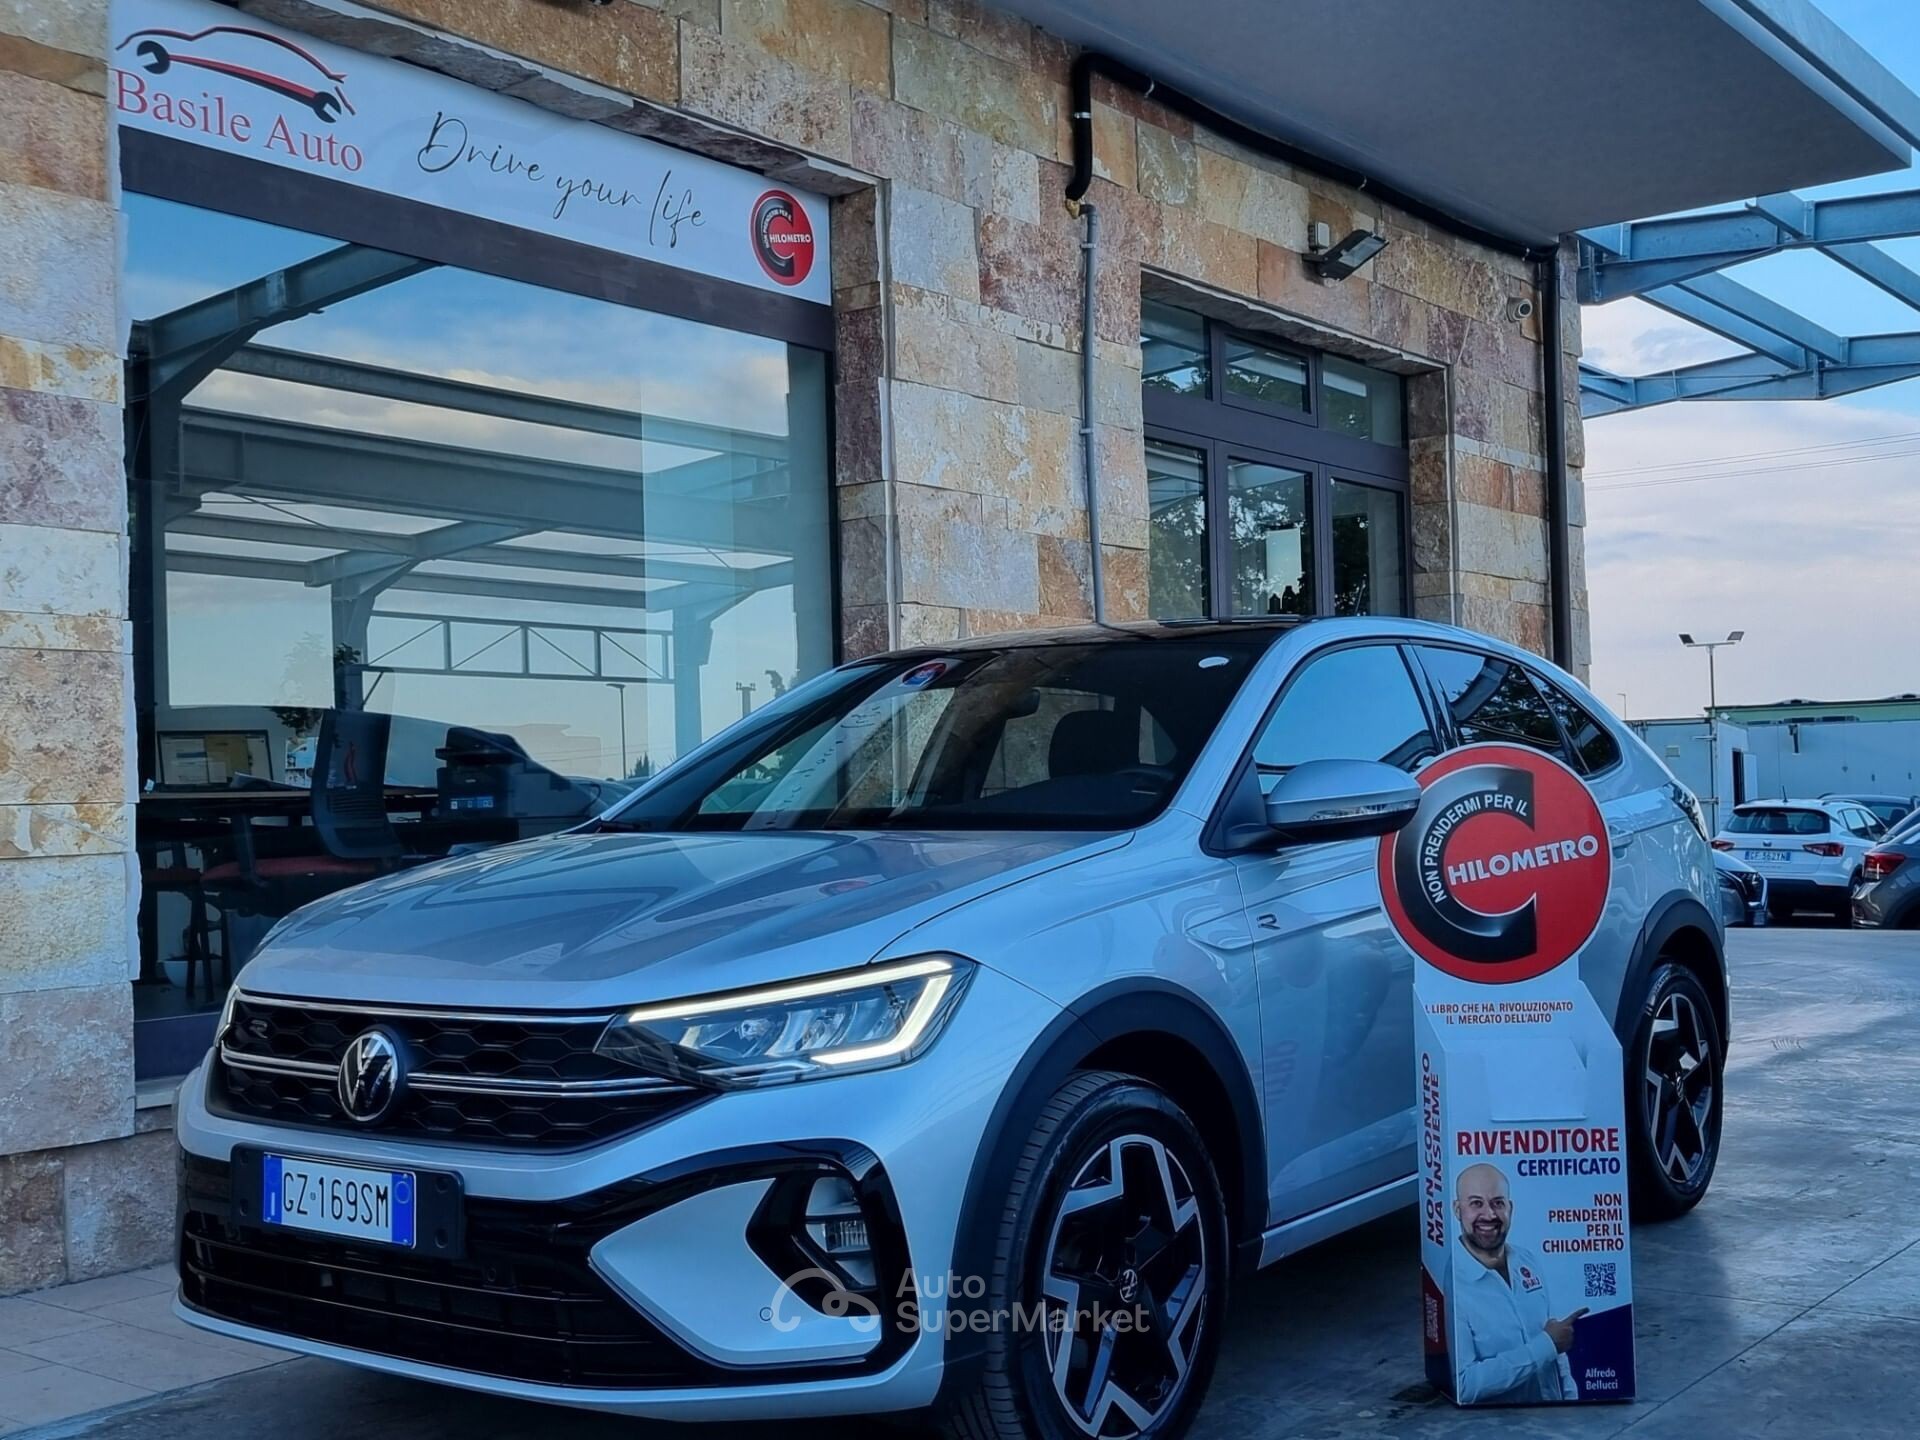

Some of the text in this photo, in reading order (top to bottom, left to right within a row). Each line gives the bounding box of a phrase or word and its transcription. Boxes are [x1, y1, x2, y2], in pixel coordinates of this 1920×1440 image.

[109, 68, 364, 172] Basile Auto
[417, 111, 706, 249] Drive your life
[1424, 793, 1529, 904] NON PRENDERMI PER IL
[1431, 1003, 1459, 1014] LIBRO
[1461, 1003, 1480, 1013] CHE
[1482, 1002, 1495, 1013] HA
[1499, 1001, 1574, 1013] RIVOLUZIONATO
[1446, 1013, 1552, 1025] IL MERCATO DELL'AUTO
[1421, 1053, 1435, 1241] NON CONTRO
[1457, 1128, 1620, 1156] RIVENDITORE
[1430, 1073, 1444, 1247] MA INSIEME
[1517, 1157, 1620, 1177] CERTIFICATO
[283, 1171, 308, 1215] GZ
[318, 1176, 389, 1228] 169SM
[1594, 1193, 1622, 1207] NON
[1548, 1208, 1623, 1223] PRENDERMI
[1587, 1223, 1624, 1237] PER IL
[1542, 1238, 1624, 1253] CHILOMETRO
[1585, 1367, 1616, 1379] Alfredo
[1585, 1378, 1618, 1390] Bellucci
